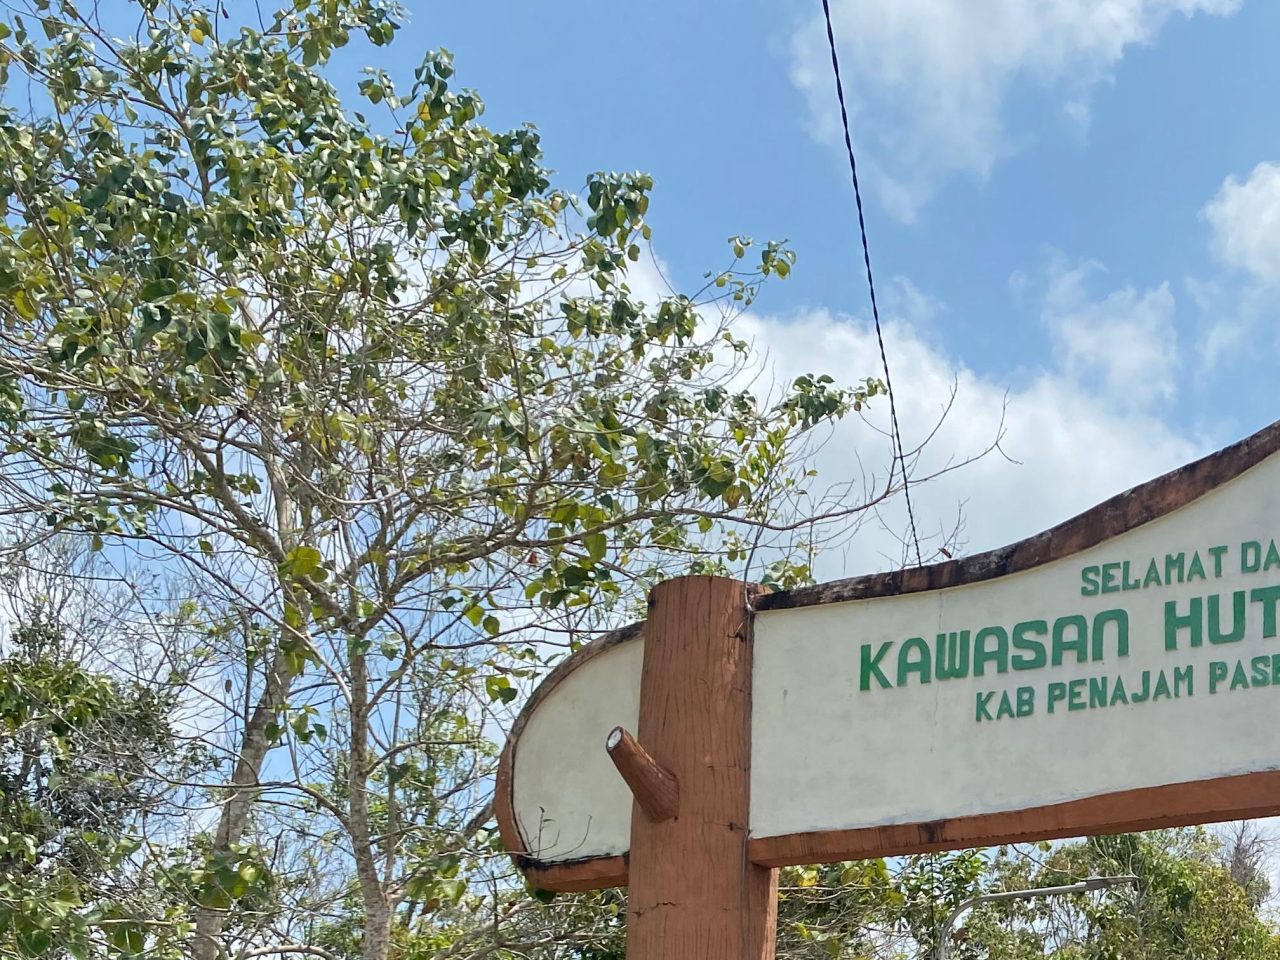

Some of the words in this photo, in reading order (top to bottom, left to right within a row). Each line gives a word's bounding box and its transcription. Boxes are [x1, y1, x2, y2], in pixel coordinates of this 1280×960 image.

[1081, 545, 1227, 596] SELAMAT
[860, 608, 1130, 691] KAWASAN
[975, 687, 1034, 723] KAB
[1047, 665, 1194, 715] PENAJAM
